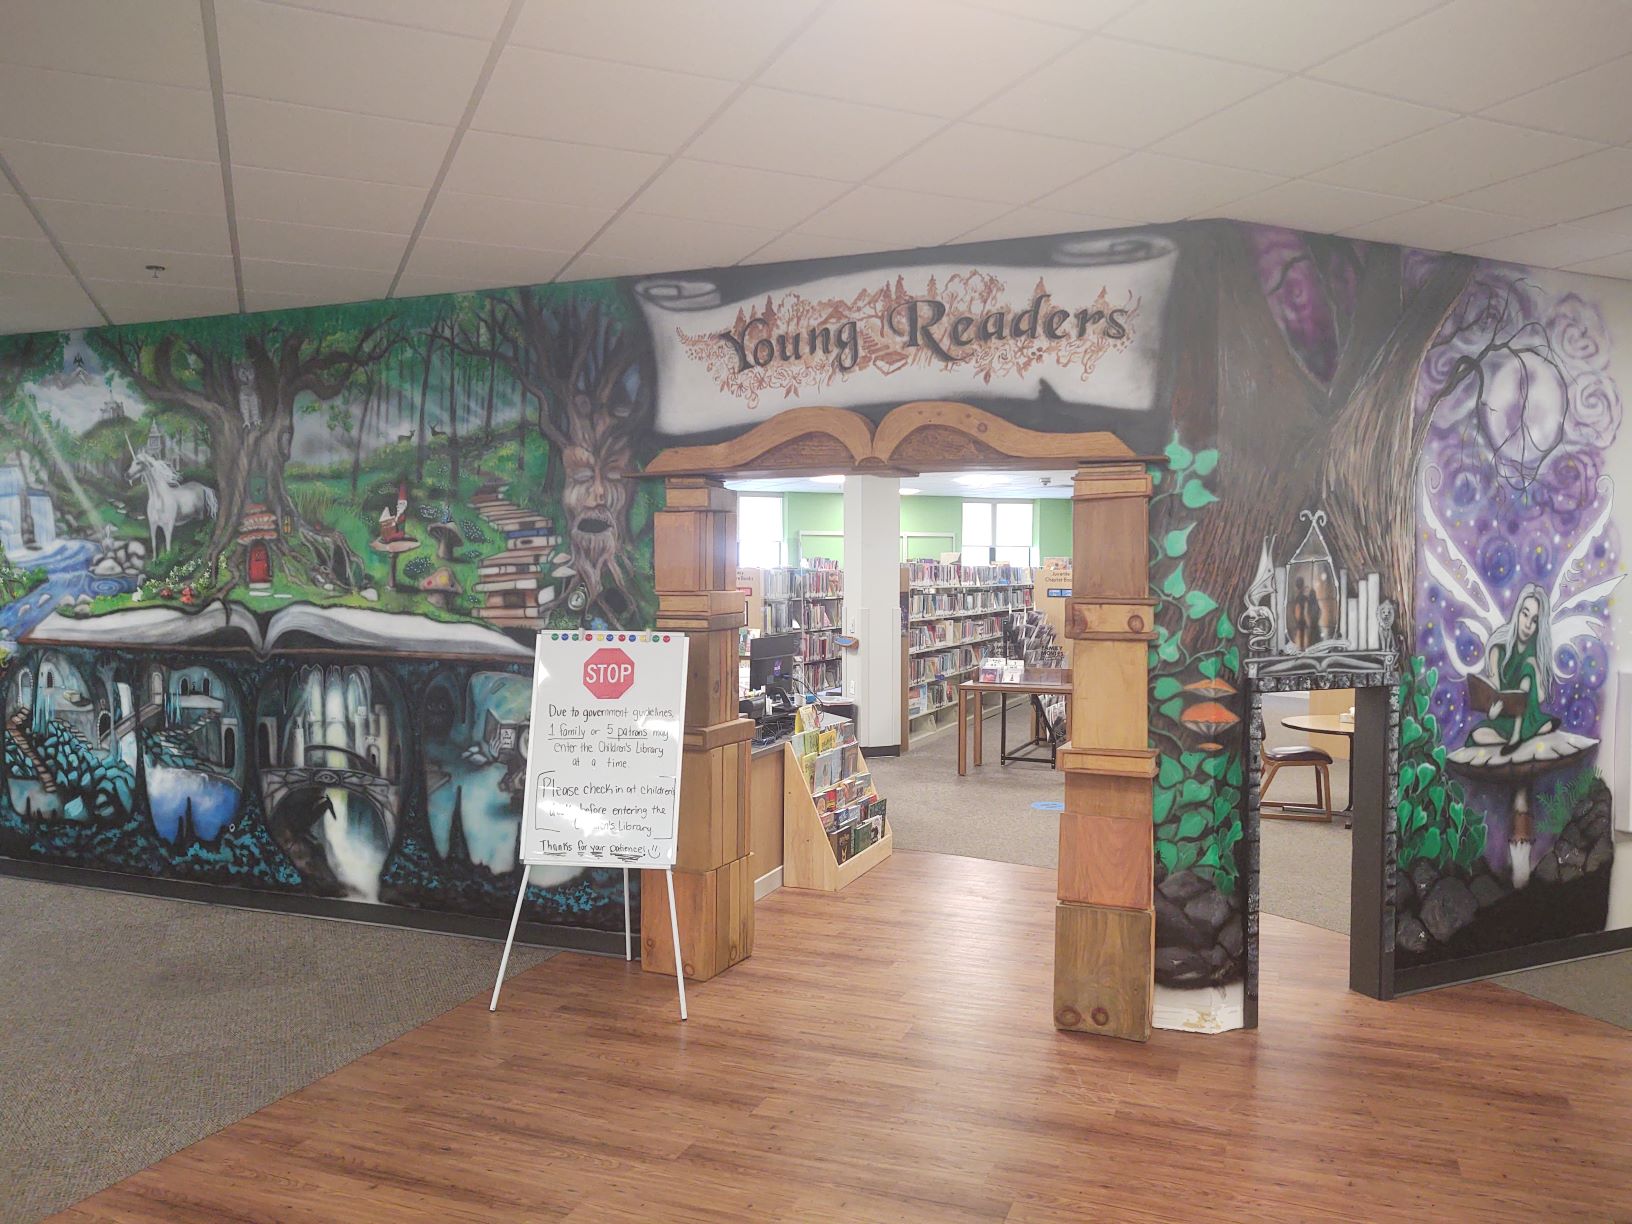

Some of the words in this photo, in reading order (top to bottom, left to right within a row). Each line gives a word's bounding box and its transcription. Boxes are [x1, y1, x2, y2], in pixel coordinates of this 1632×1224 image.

[719, 317, 858, 373] Young
[886, 293, 1130, 363] Readers
[586, 663, 632, 684] STOP
[548, 703, 567, 717] Due
[571, 706, 580, 718] to
[582, 707, 628, 722] government
[548, 723, 556, 737] 1
[559, 722, 586, 739] family
[590, 727, 601, 736] or
[606, 723, 614, 735] 5
[617, 727, 648, 741] patrons
[652, 728, 669, 741] may
[553, 741, 577, 753] enter
[580, 741, 594, 753] the
[598, 740, 632, 753] Children's
[635, 741, 664, 758] Library
[572, 757, 580, 766] at
[591, 758, 597, 767] a
[542, 776, 579, 798] Please
[583, 781, 613, 796] check
[615, 785, 624, 794] in
[626, 784, 637, 794] at
[612, 805, 648, 819] entering
[651, 804, 666, 815] the
[618, 819, 652, 838] Library
[539, 840, 573, 852] Thanks
[577, 840, 588, 852] for
[590, 843, 606, 855] your
